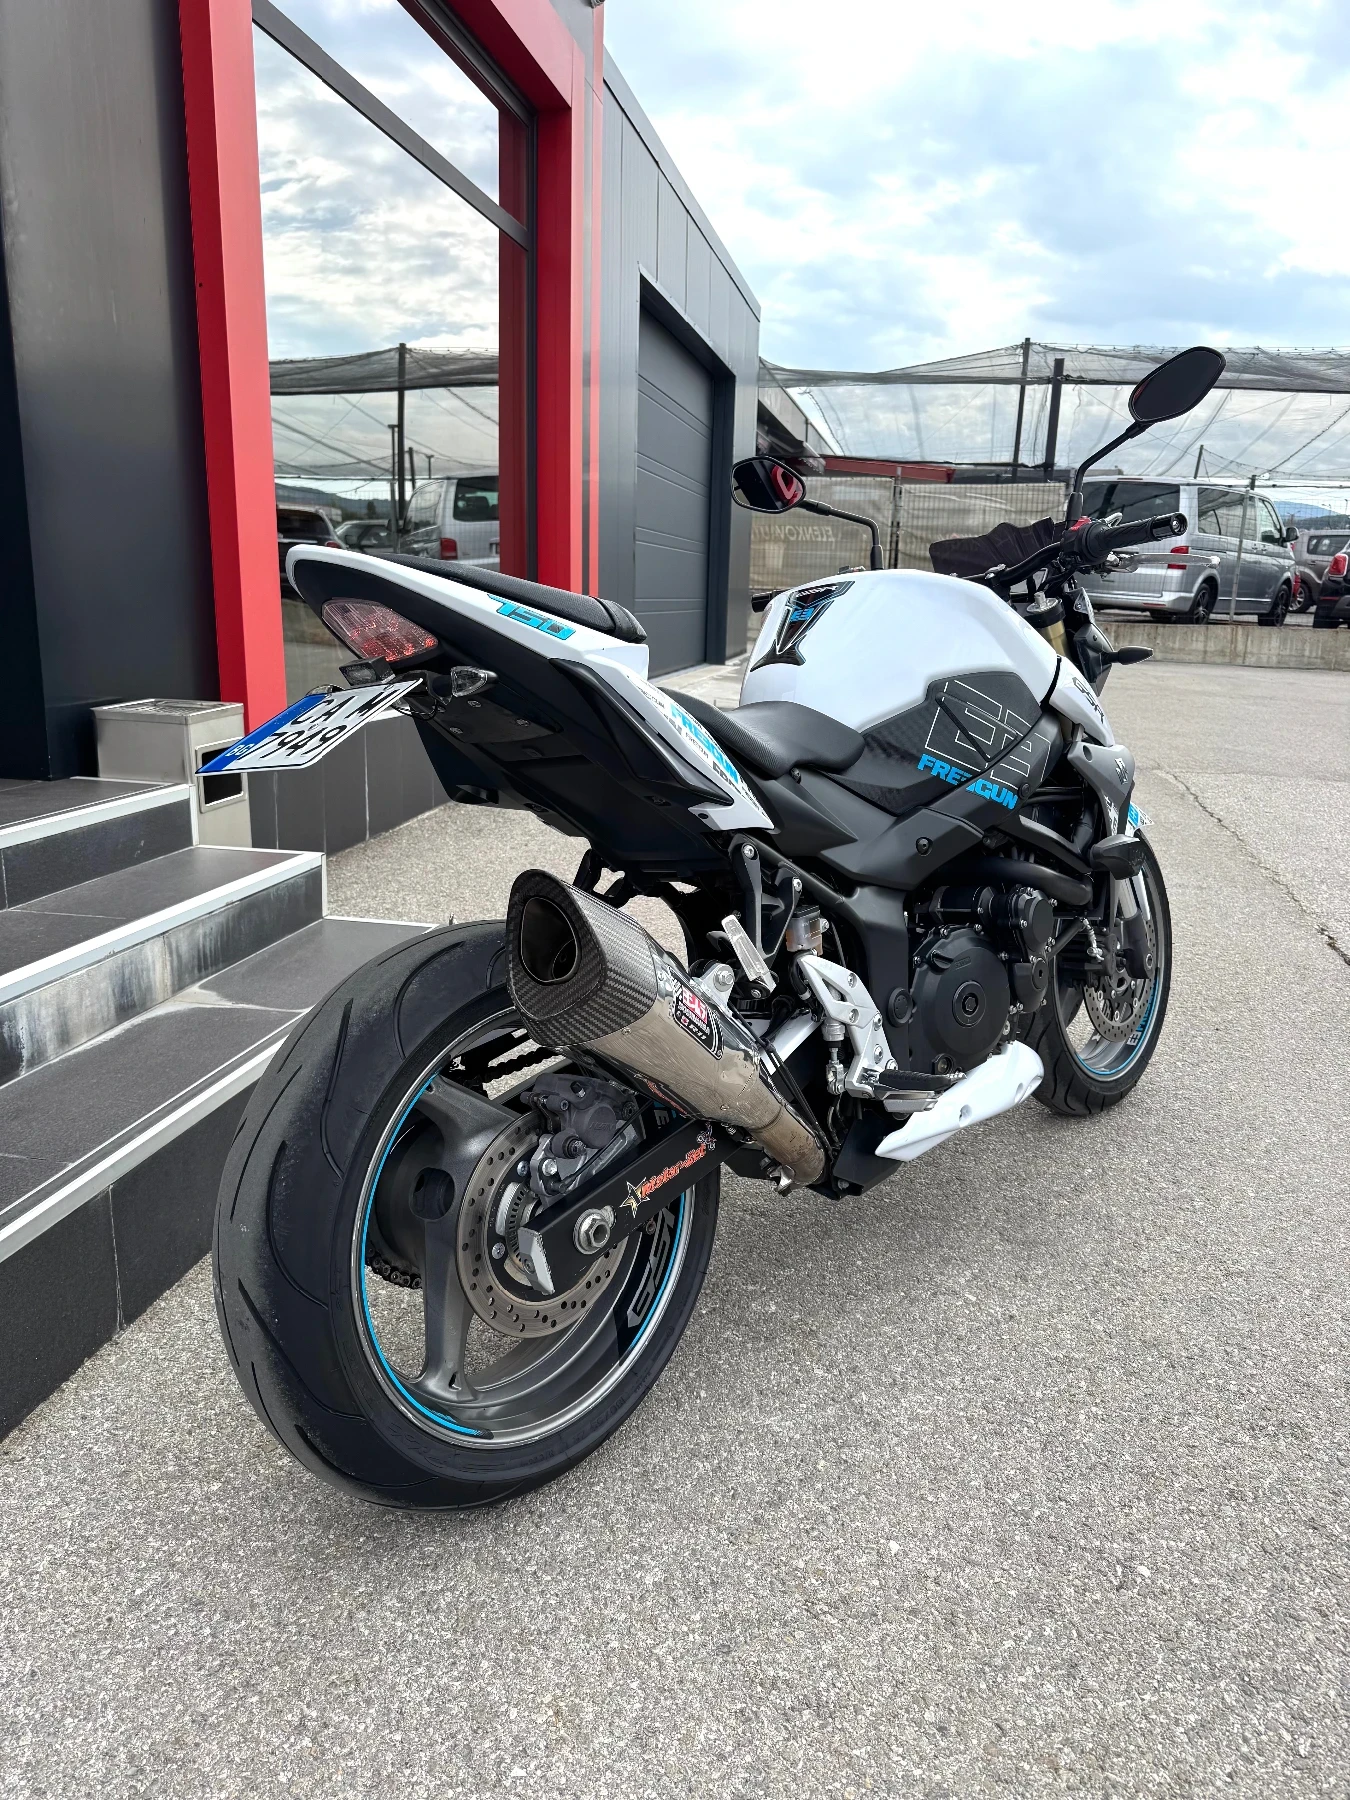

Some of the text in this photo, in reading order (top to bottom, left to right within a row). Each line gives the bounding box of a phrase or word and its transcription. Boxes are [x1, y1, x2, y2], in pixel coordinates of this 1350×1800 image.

[487, 594, 576, 640] 750
[225, 743, 255, 757] BG
[236, 724, 348, 761] 7949
